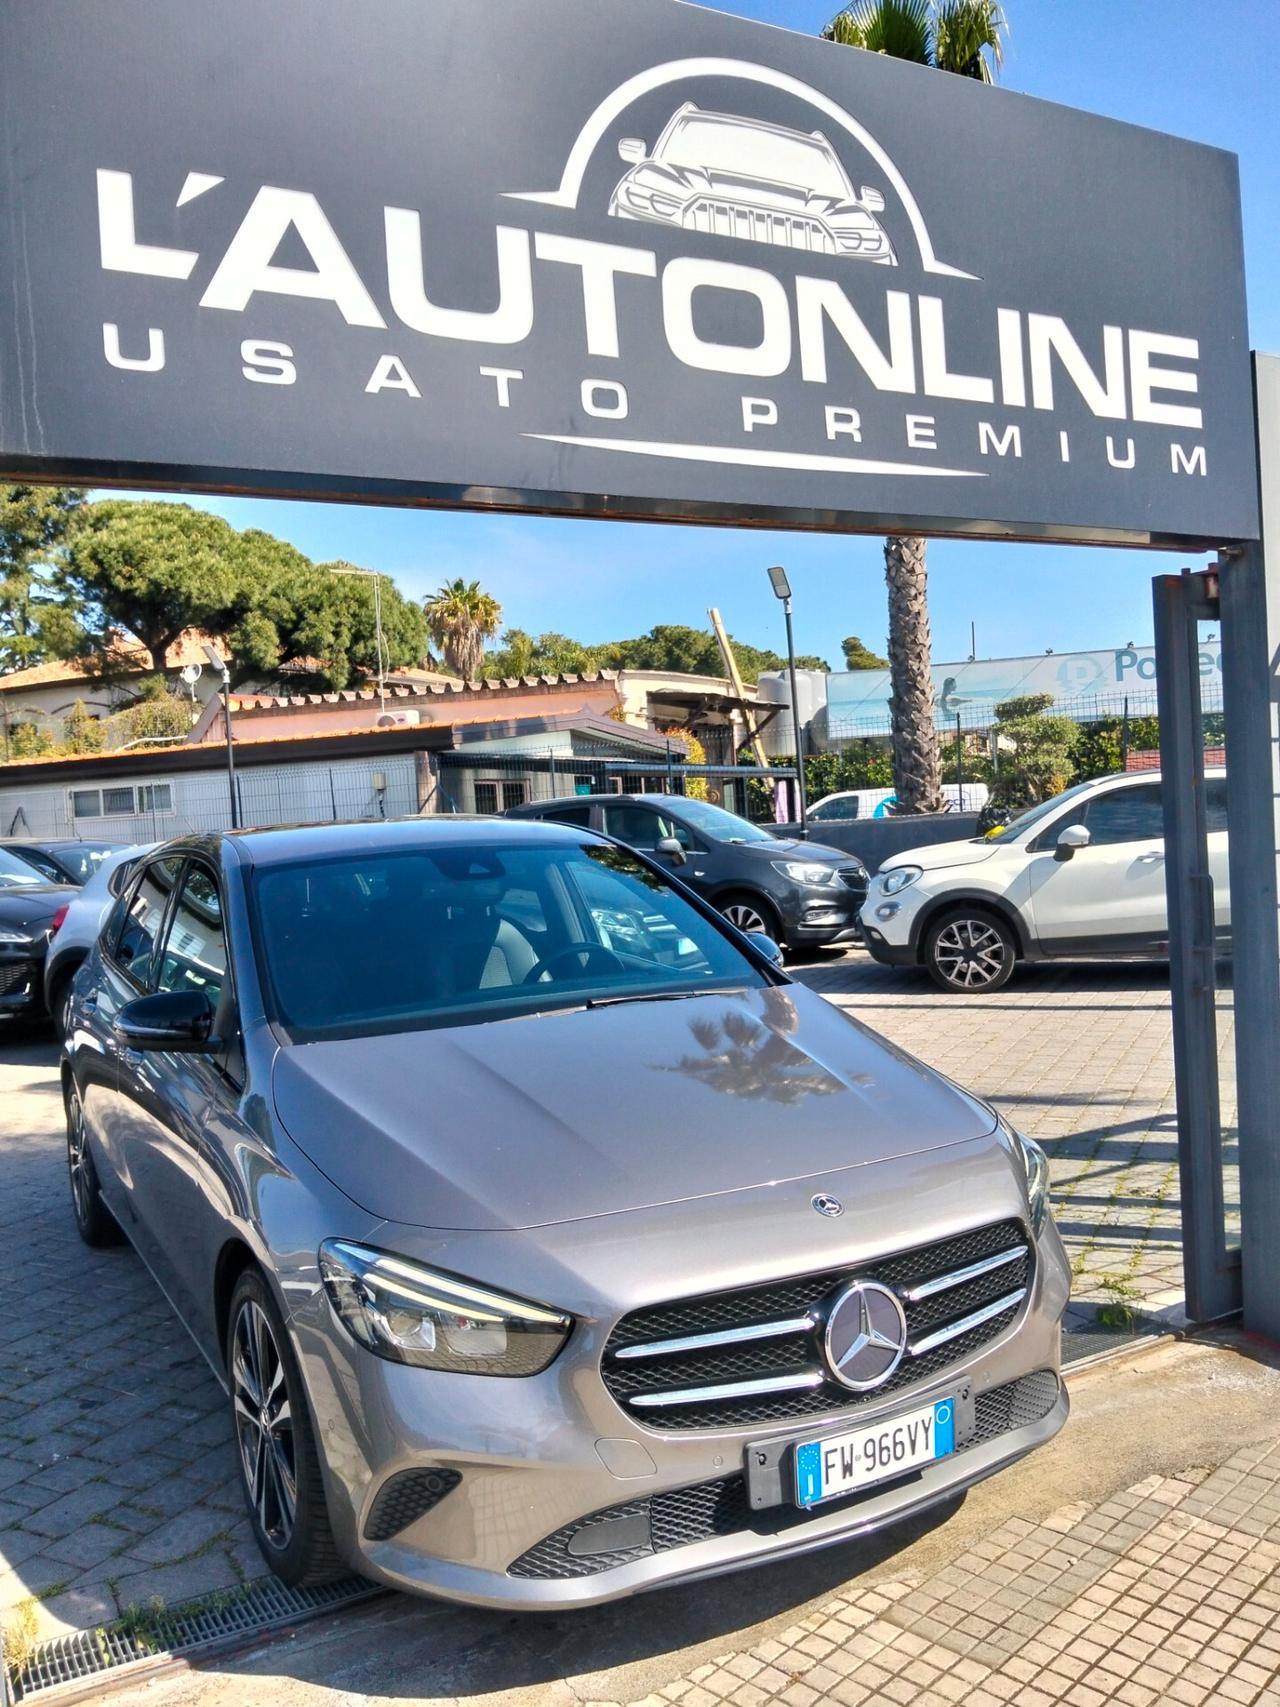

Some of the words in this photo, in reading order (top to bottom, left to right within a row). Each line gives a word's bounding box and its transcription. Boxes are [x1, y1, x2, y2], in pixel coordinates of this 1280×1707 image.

[96, 168, 1204, 430] L'AUTONLINE
[102, 322, 629, 420] USATO
[740, 395, 1208, 477] PREMIUM
[824, 1444, 854, 1485] FW
[864, 1417, 932, 1472] 966VY
